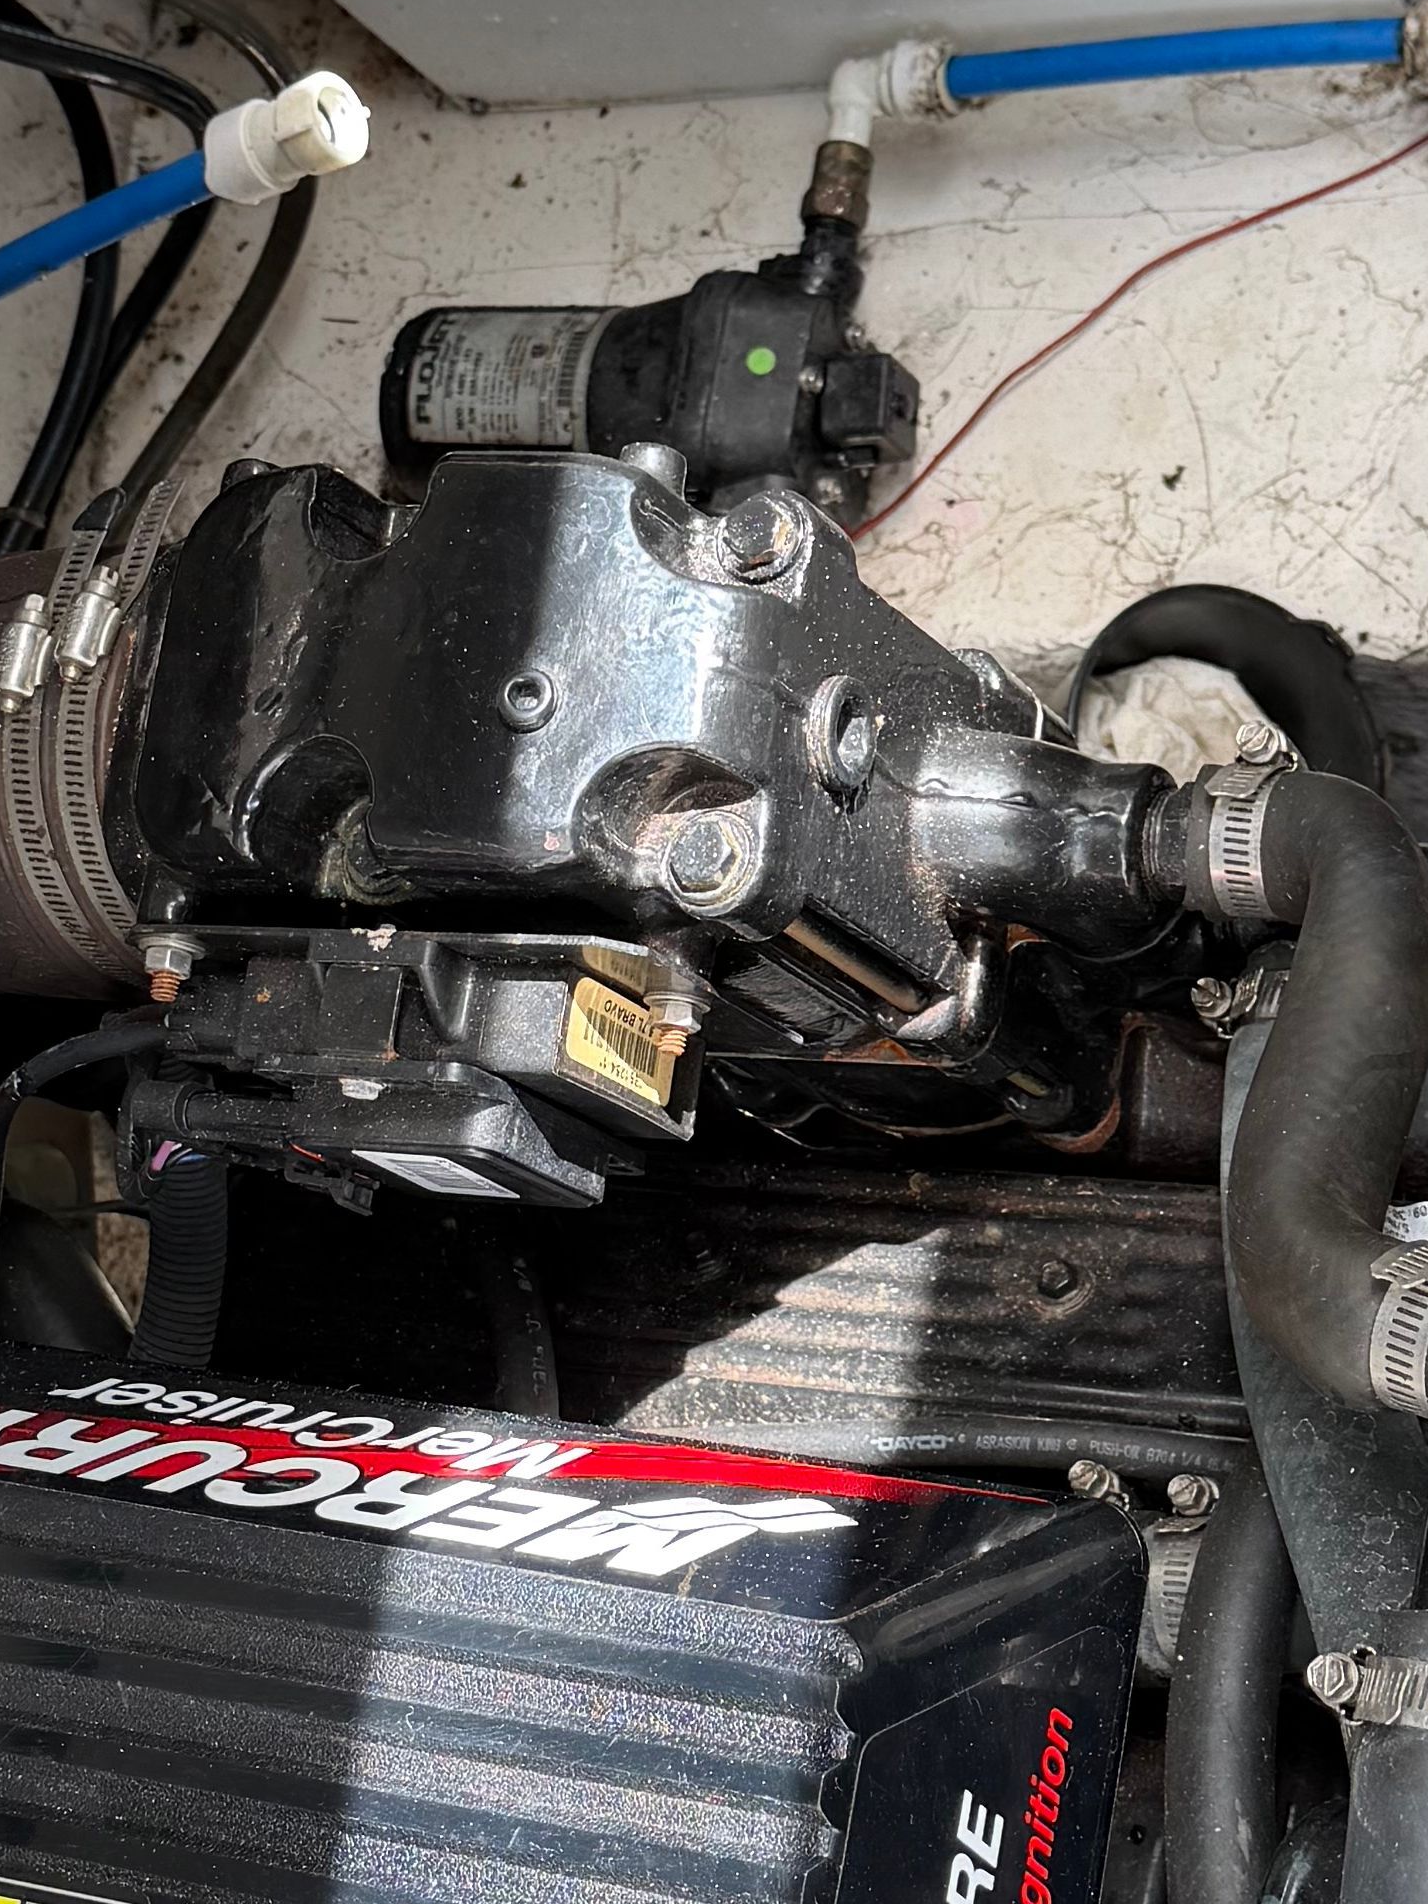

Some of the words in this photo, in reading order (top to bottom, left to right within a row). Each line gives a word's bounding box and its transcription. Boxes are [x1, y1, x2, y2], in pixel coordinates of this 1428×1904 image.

[407, 313, 458, 427] FLOJET
[600, 999, 638, 1027] BRAVO
[44, 1370, 592, 1487] MerCruiser
[876, 1435, 948, 1451] DAYCO
[974, 1436, 1031, 1452] ABRASION
